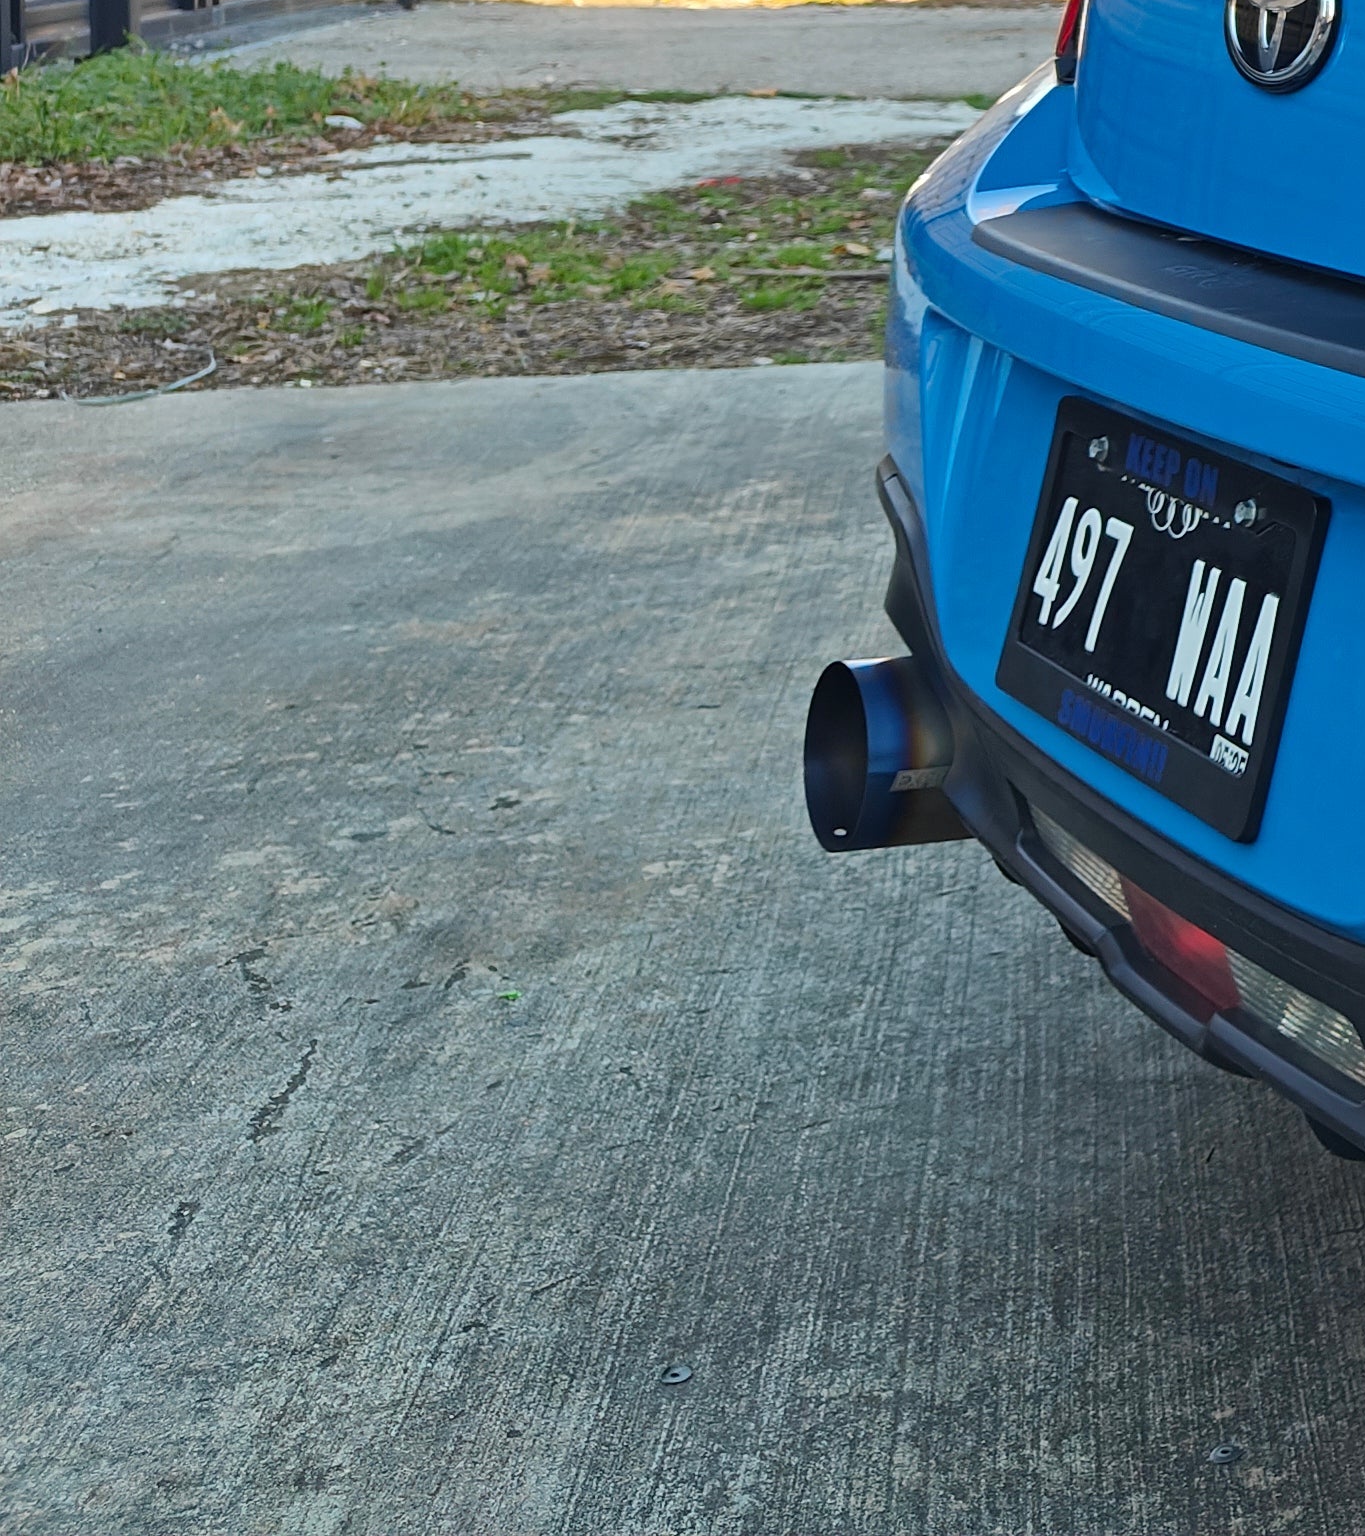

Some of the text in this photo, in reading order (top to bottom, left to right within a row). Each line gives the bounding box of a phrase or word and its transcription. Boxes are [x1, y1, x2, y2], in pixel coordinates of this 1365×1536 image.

[1125, 433, 1181, 488] KEEP
[1184, 457, 1219, 507] ON
[1033, 496, 1280, 746] 497 WAA
